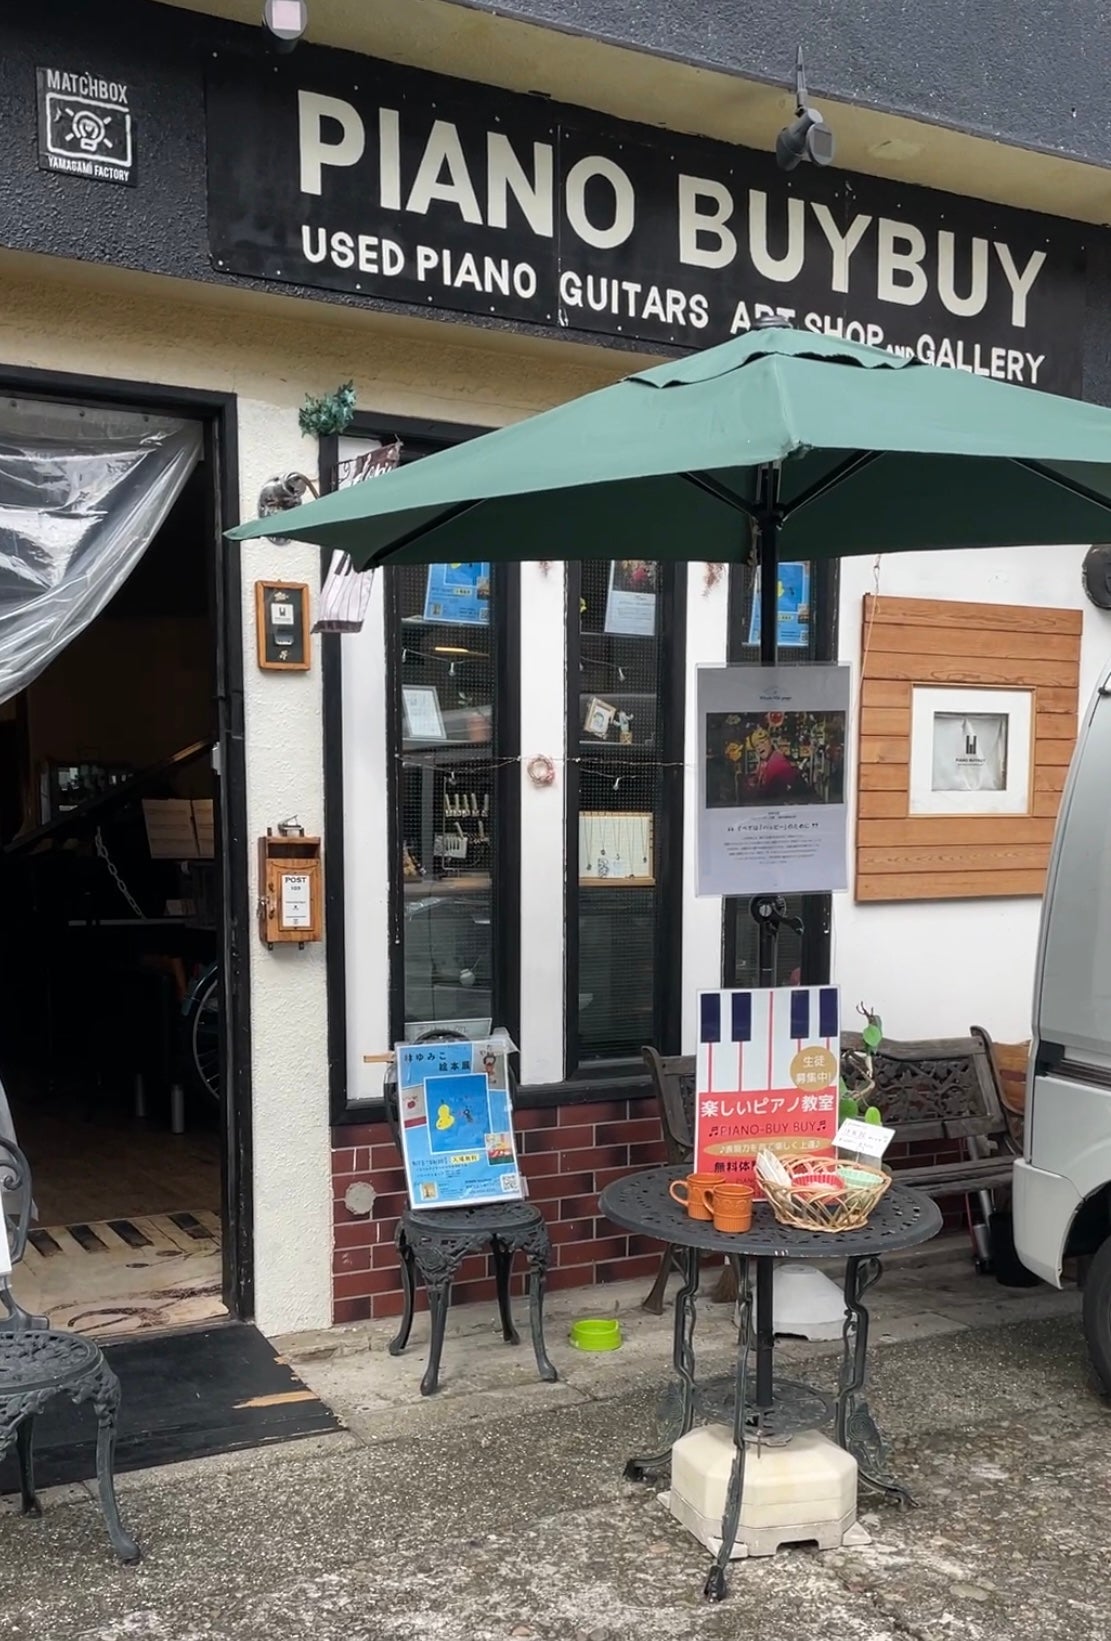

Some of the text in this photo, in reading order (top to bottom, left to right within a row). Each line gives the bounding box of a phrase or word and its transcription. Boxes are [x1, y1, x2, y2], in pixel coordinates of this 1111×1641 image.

[47, 69, 128, 104] MATCHBOX
[94, 164, 129, 182] FACTORY
[297, 89, 1047, 328] PIANO BUYBUY
[301, 224, 405, 276] USED
[416, 245, 537, 299] PIANO
[559, 271, 709, 328] GUITARS
[916, 333, 1045, 384] GALLERY
[803, 1055, 825, 1068] 生徒
[701, 1095, 834, 1117] 楽しいピアノ教室
[793, 1121, 818, 1133] BUY
